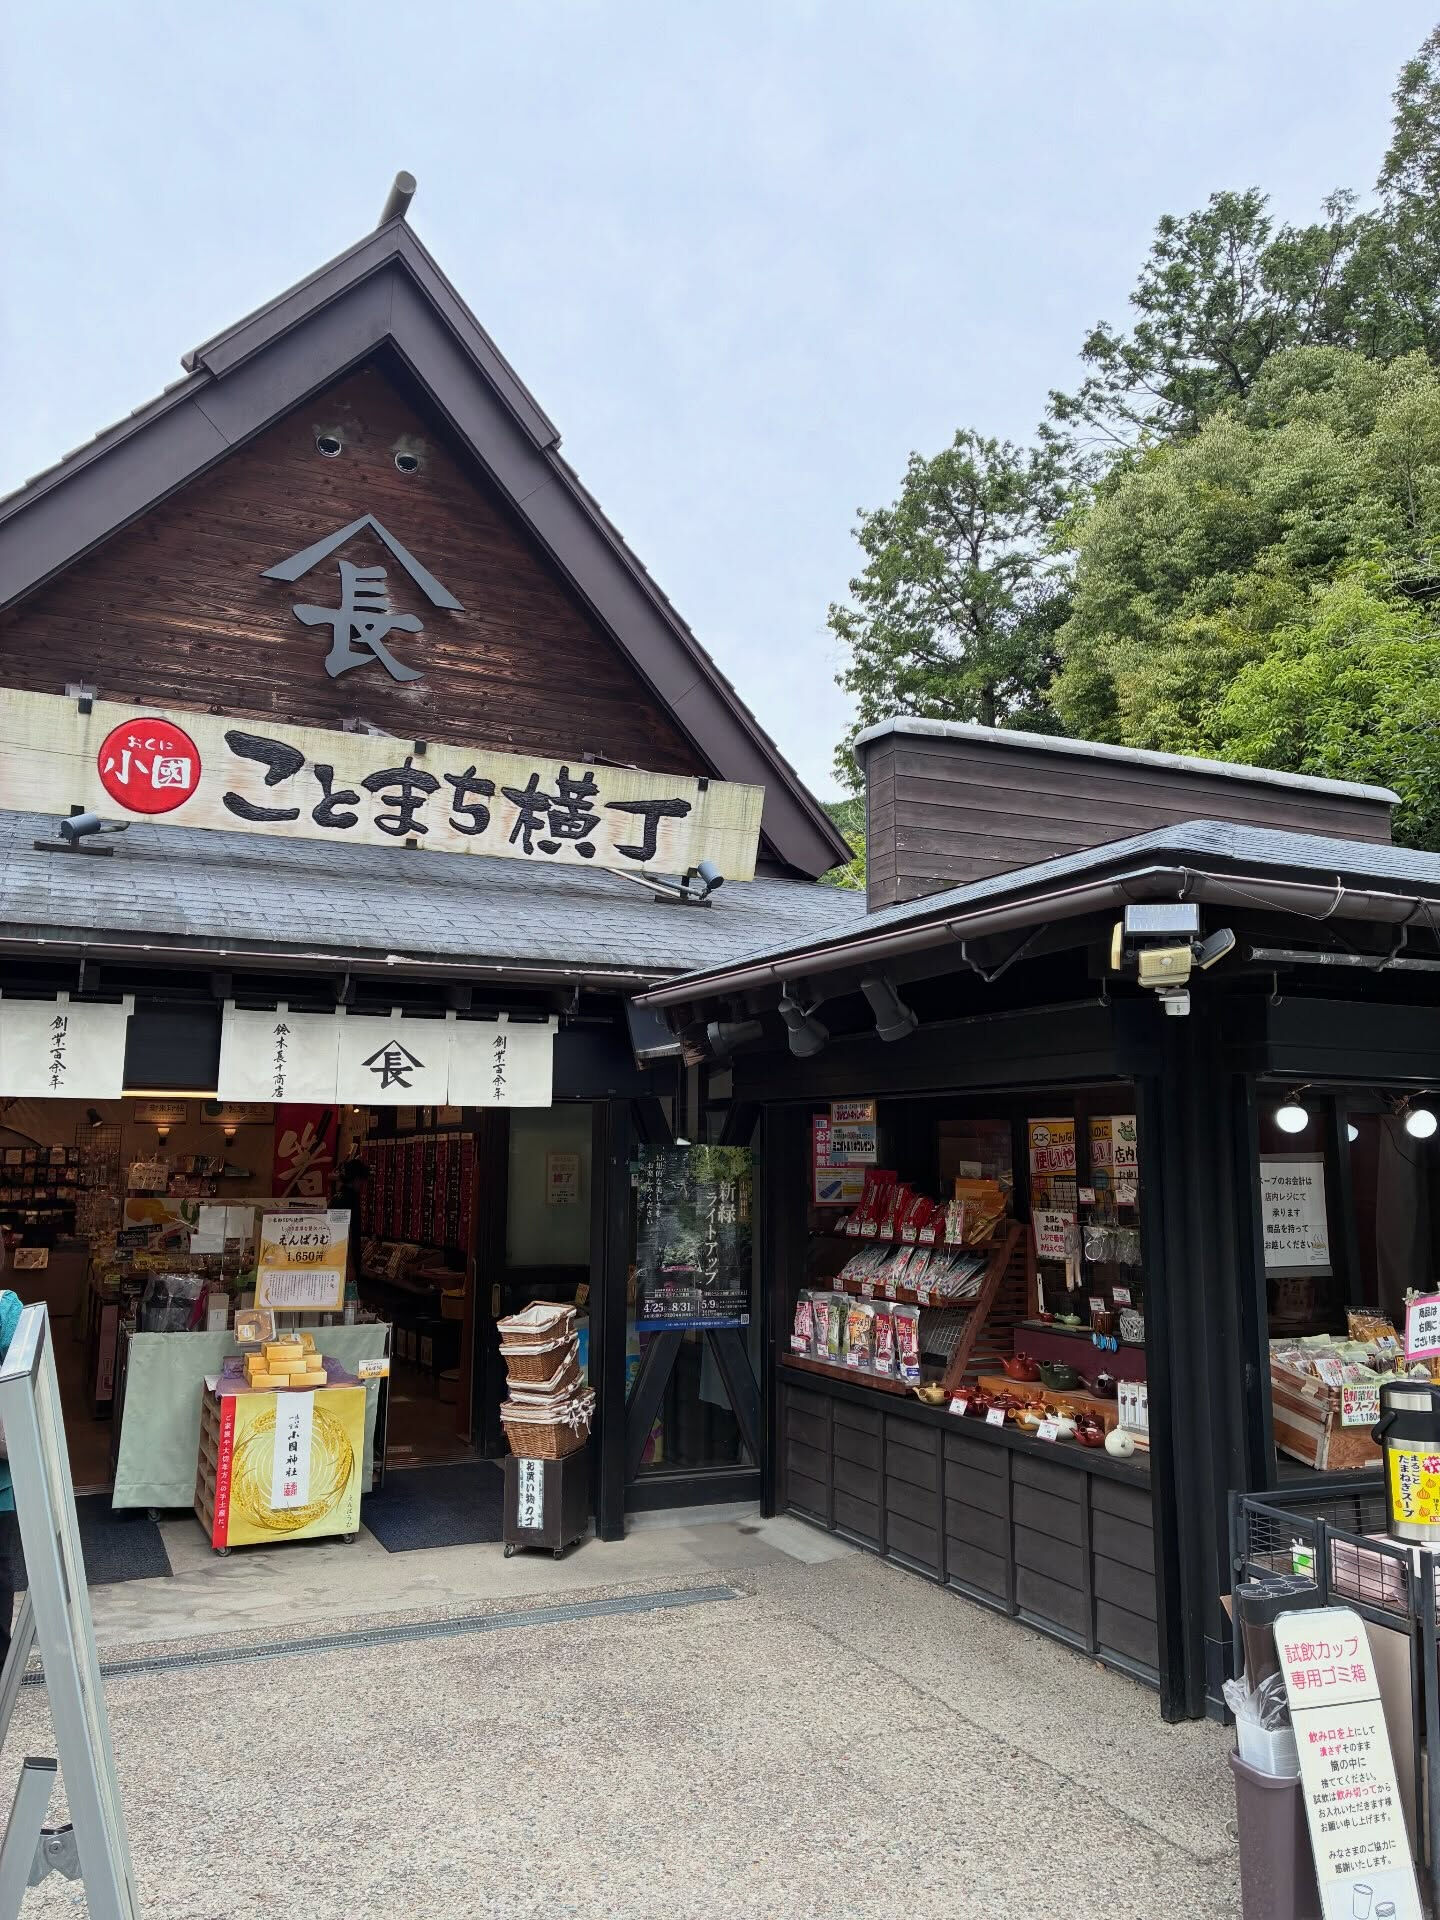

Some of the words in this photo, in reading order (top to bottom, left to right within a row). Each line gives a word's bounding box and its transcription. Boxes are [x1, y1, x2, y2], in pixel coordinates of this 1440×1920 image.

[127, 735, 174, 751] おくに
[223, 729, 692, 862] ことまち横丁
[49, 1016, 68, 1090] 創業百余年
[492, 1035, 507, 1100] 創業百余年
[1115, 1146, 1134, 1163] 店内
[718, 1182, 735, 1224] 新緑
[1265, 1192, 1307, 1202] 店内レジにて
[1272, 1208, 1301, 1217] 承ります
[705, 1192, 718, 1286] ライトアップ
[1266, 1224, 1309, 1234] 商品を持って
[279, 1233, 329, 1246] えんばうむ
[1265, 1240, 1314, 1250] お越しください
[1418, 1305, 1437, 1319] 商品は
[1410, 1454, 1421, 1485] まるごと
[525, 1461, 535, 1526] お買い物カゴ
[1398, 1454, 1415, 1518] たまねぎスープ
[1284, 1636, 1359, 1664] 試飲カップ
[1290, 1664, 1367, 1690] 専用ゴミ箱
[1308, 1725, 1376, 1744] 飲み口を上にして
[1319, 1741, 1372, 1758] 潰さずそのまま
[1320, 1773, 1377, 1789] 捨ててください。
[1313, 1782, 1393, 1806] 試飲は飲み切ってから
[1318, 1797, 1394, 1819] お入れいただきます様
[1320, 1812, 1393, 1833] お願い申し上げます。
[1328, 1839, 1397, 1859] みなさまのご協力に
[1334, 1854, 1393, 1874] 感謝いたします。
